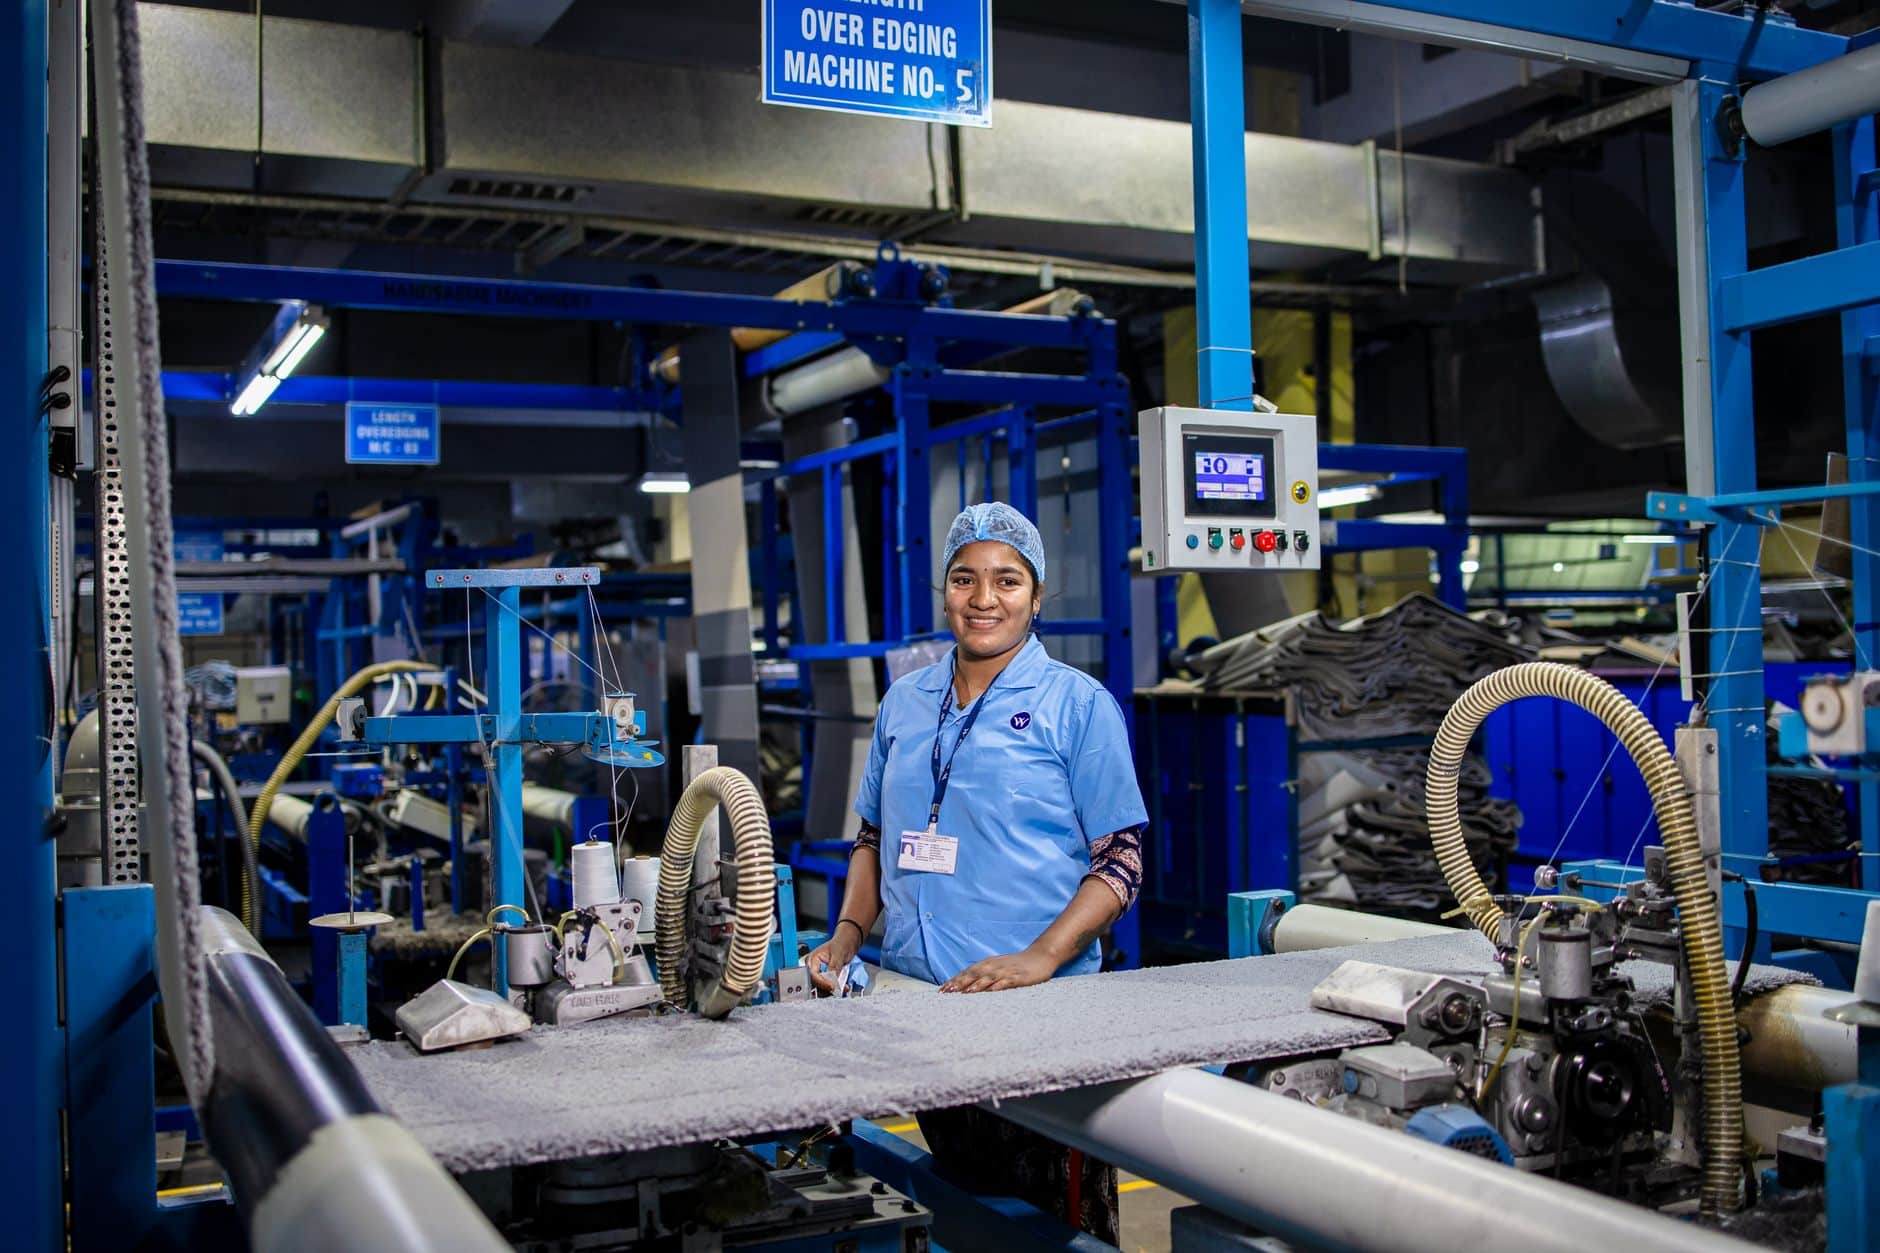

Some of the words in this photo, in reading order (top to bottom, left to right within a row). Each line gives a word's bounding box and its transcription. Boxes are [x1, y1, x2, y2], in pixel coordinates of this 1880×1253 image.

[801, 8, 864, 47] OVER
[872, 18, 957, 58] EDGING
[784, 50, 894, 94] MACHINE
[903, 65, 945, 99] NO-
[956, 70, 973, 102] 5
